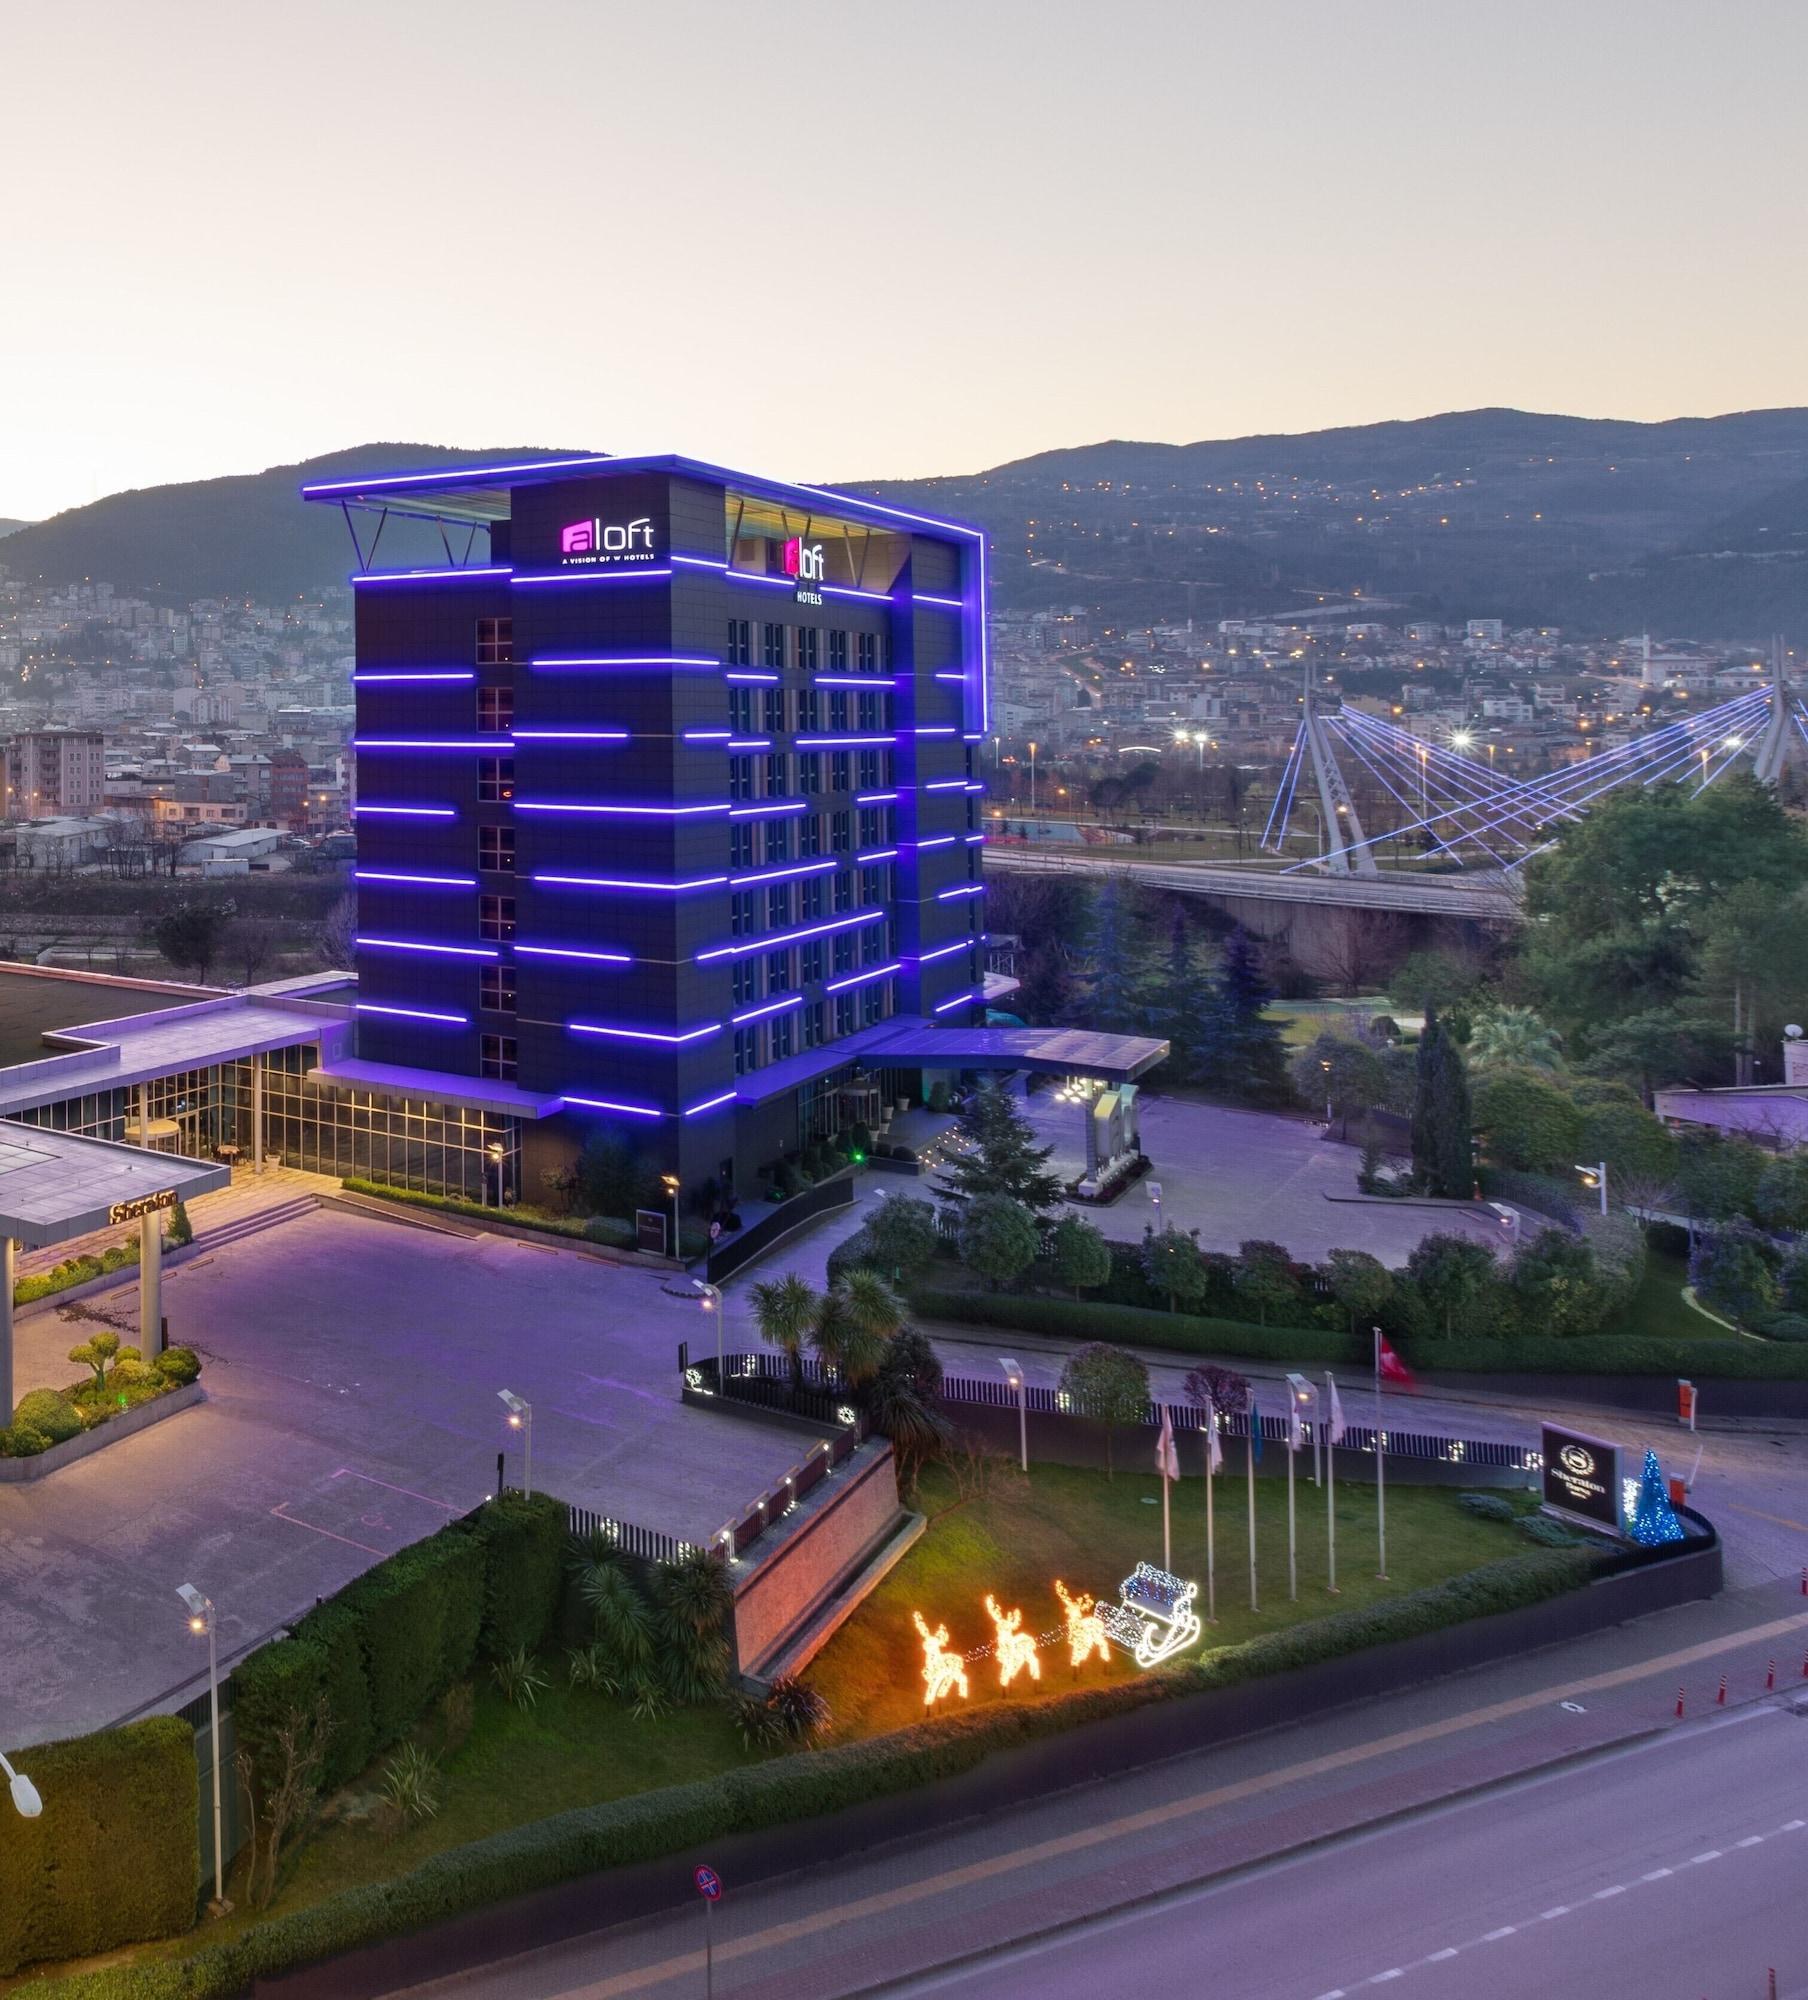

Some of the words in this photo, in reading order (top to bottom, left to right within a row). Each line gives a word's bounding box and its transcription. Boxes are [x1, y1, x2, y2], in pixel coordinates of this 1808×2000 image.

[562, 518, 654, 553] aloft
[570, 556, 597, 564] VISION
[624, 553, 655, 561] HOTELS
[797, 591, 822, 606] HOTELS
[109, 1189, 178, 1225] Sheraton
